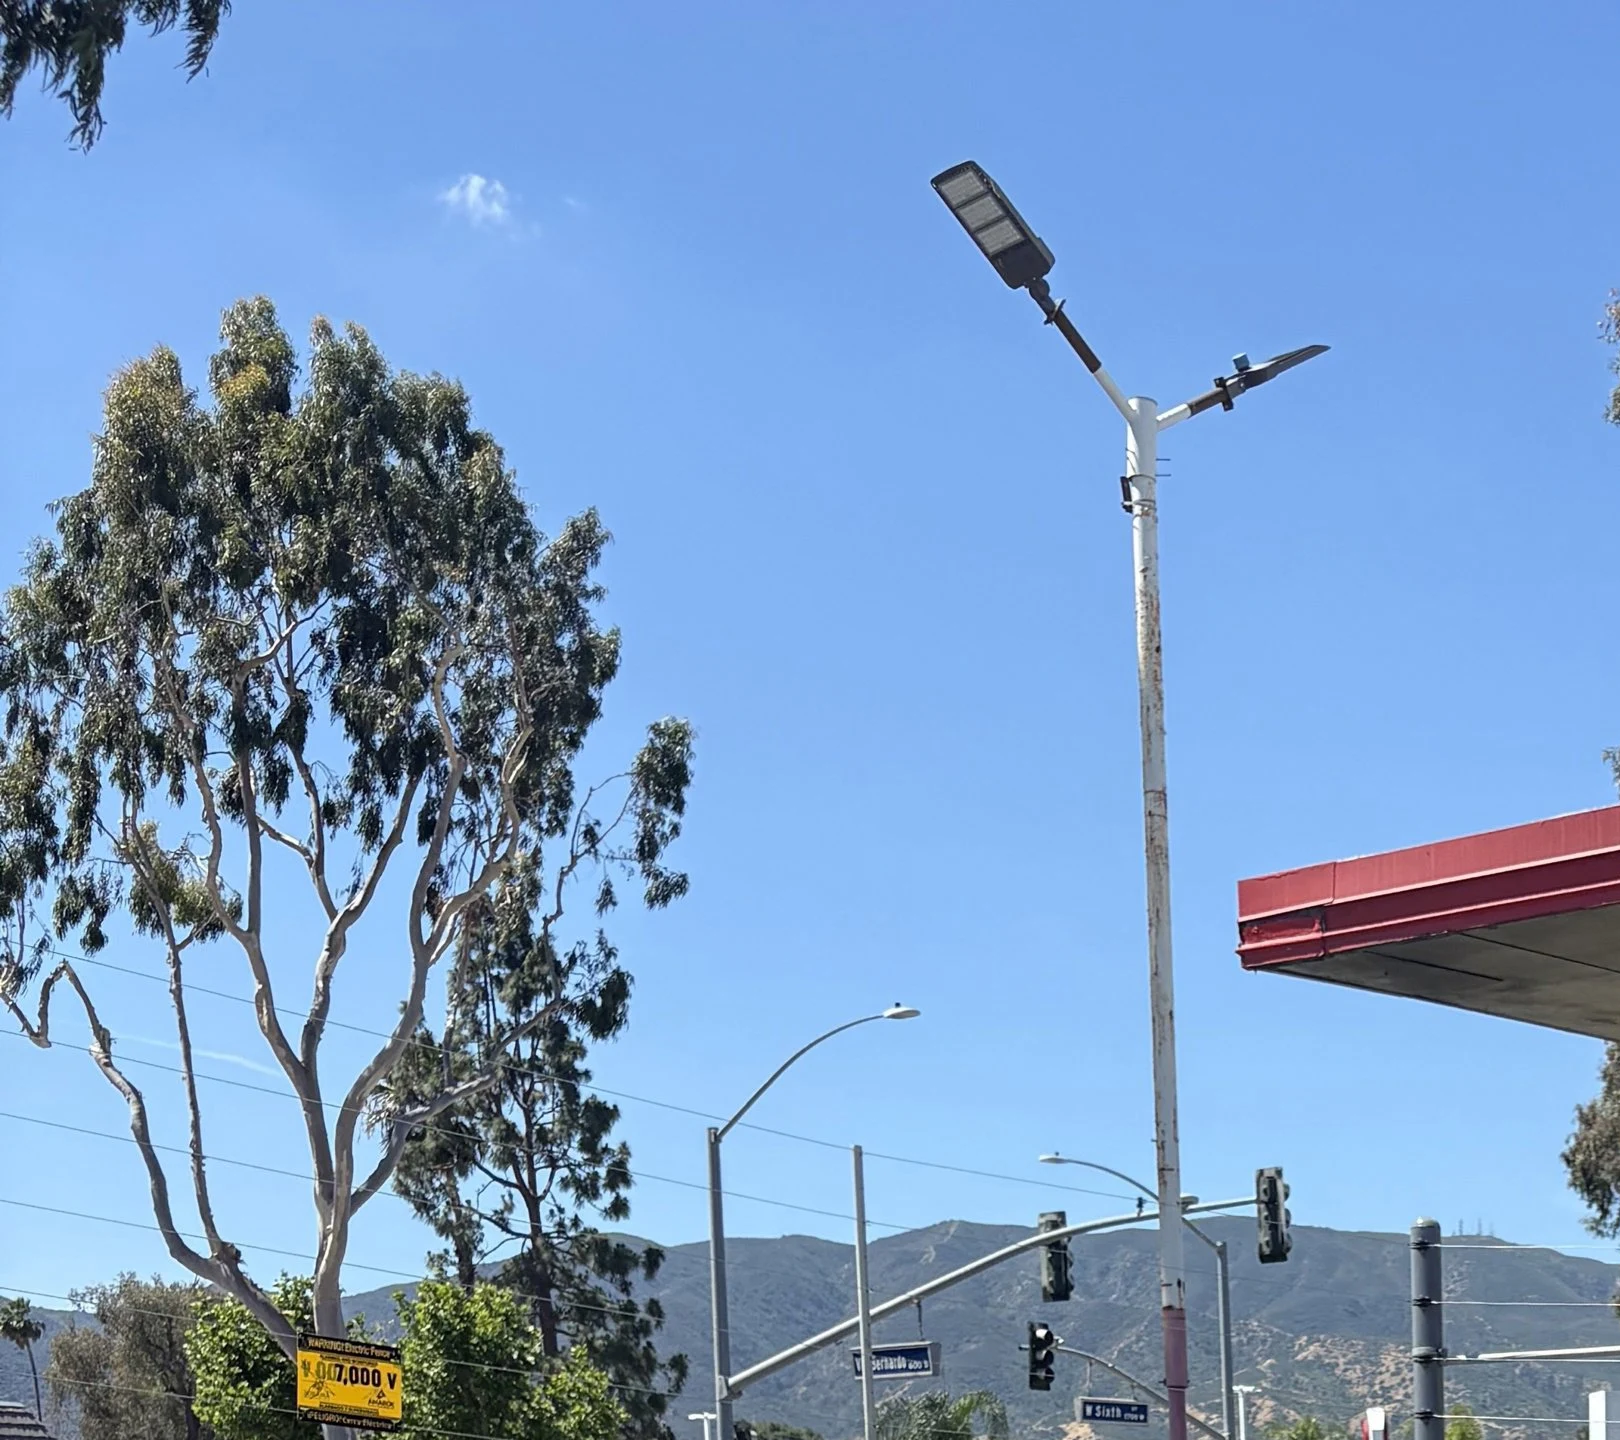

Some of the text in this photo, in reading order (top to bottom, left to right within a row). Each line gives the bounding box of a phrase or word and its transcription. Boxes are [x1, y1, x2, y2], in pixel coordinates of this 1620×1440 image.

[334, 1363, 398, 1391] 7,000 V
[1095, 1405, 1122, 1418] Sixth
